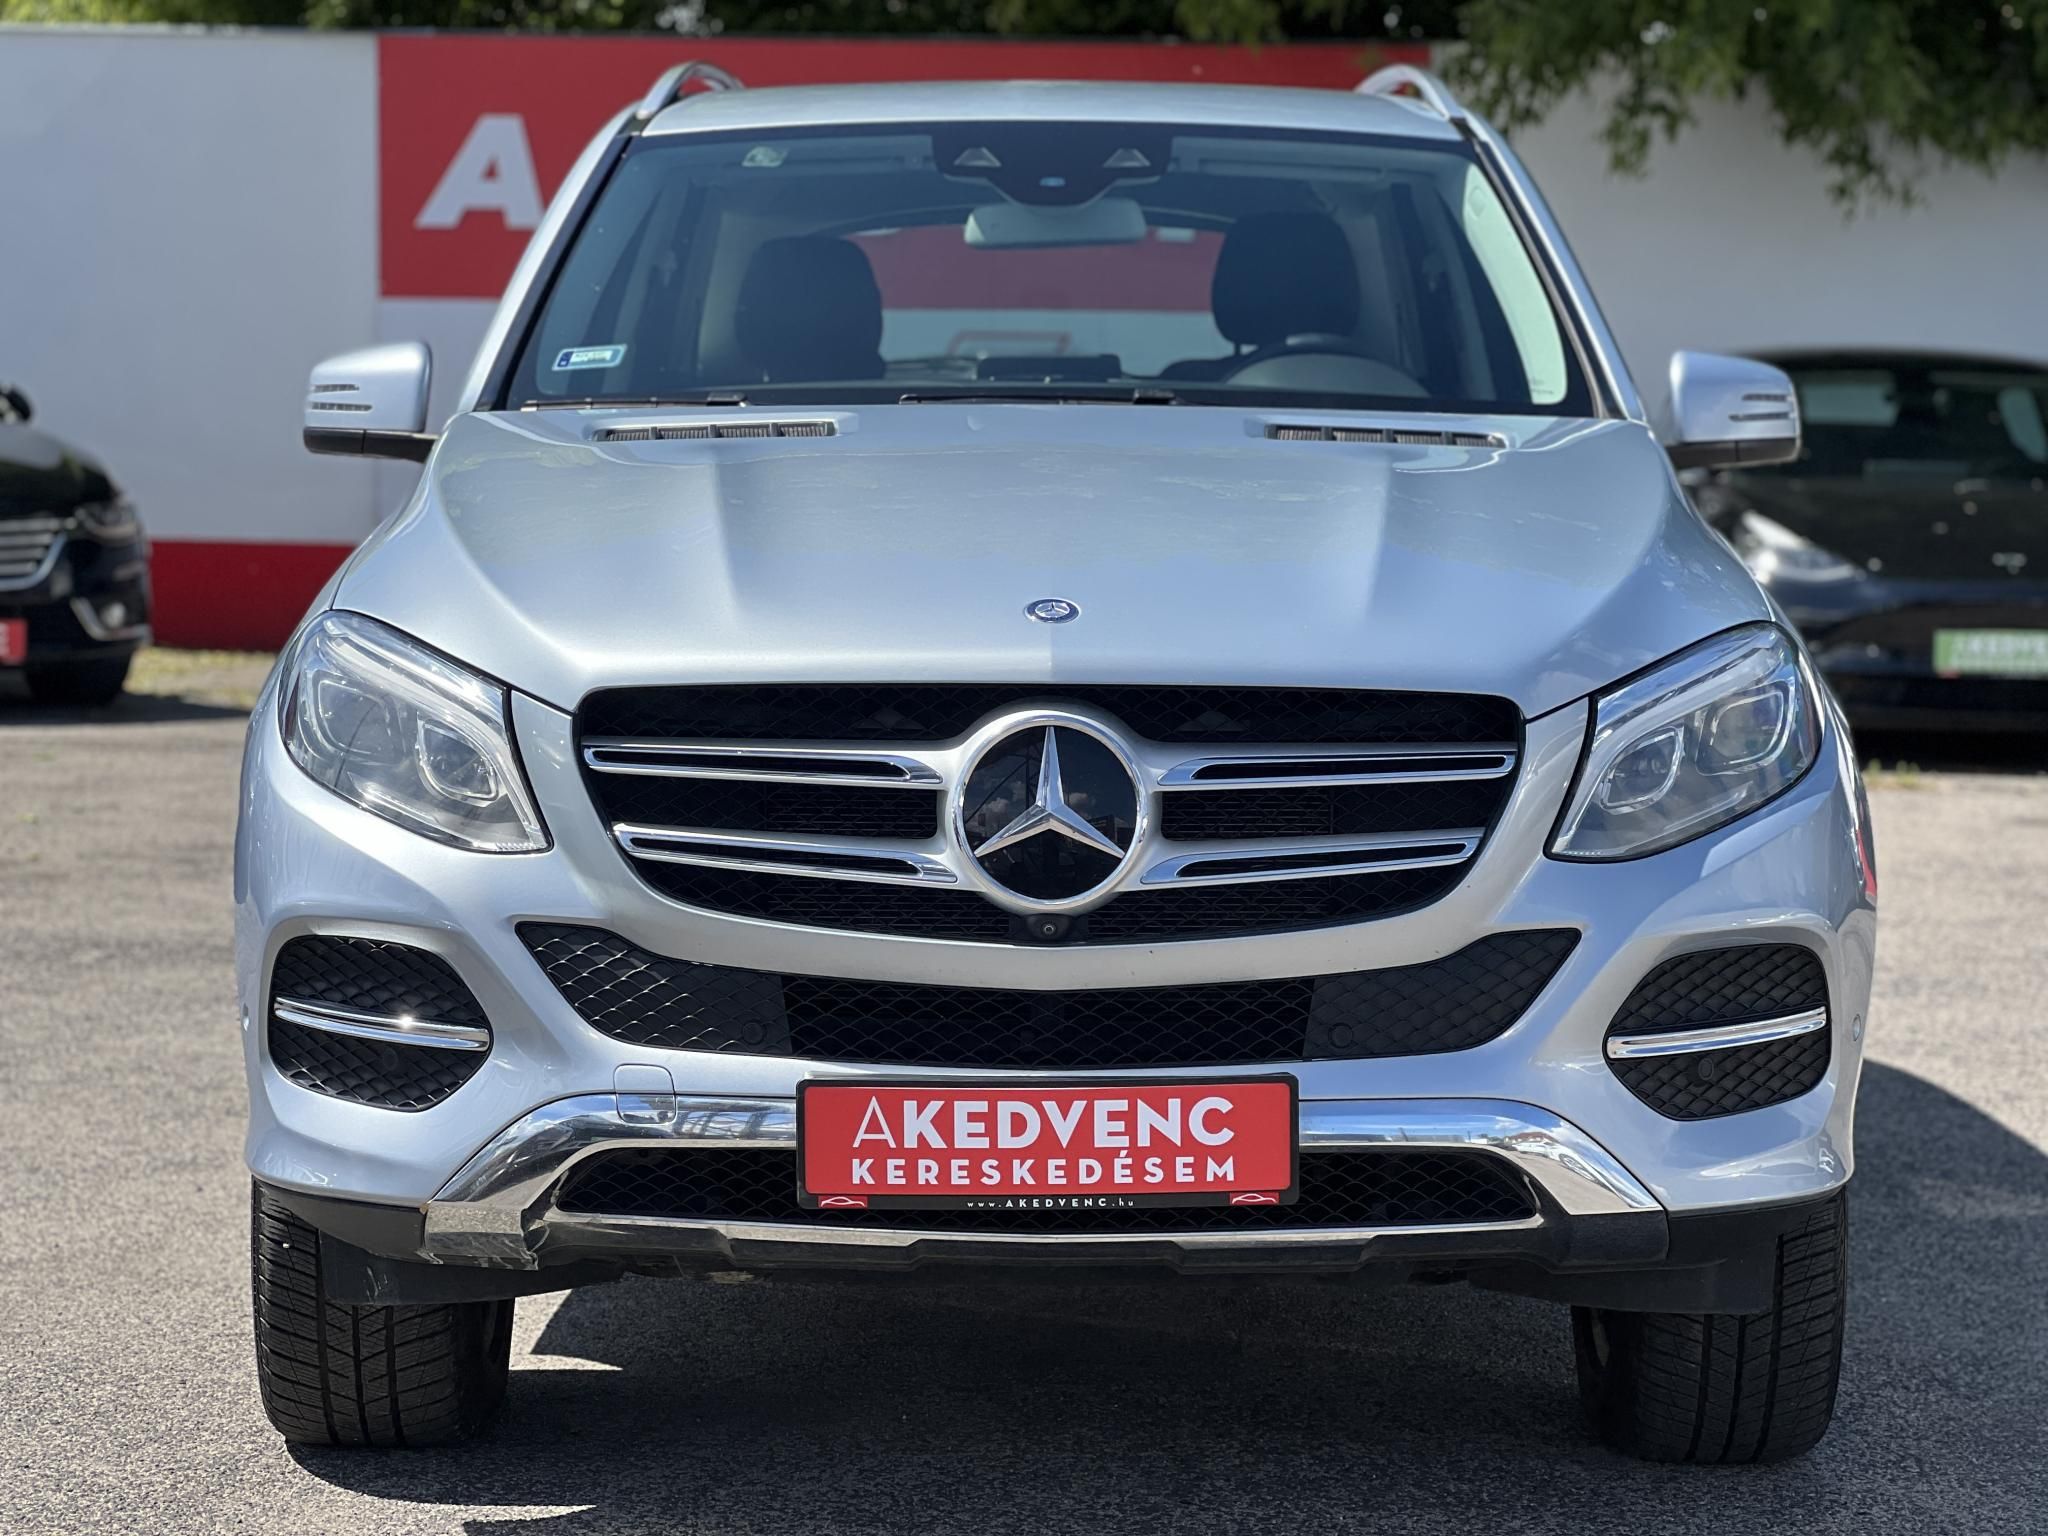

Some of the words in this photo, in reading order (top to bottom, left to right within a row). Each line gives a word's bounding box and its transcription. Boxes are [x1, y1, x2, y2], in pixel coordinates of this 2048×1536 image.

[413, 112, 546, 229] A
[852, 1096, 1235, 1149] AKEDVENC
[852, 1150, 1236, 1185] KERESKEDÉSEM
[967, 1197, 1134, 1208] www.AKEDVENC.hu
